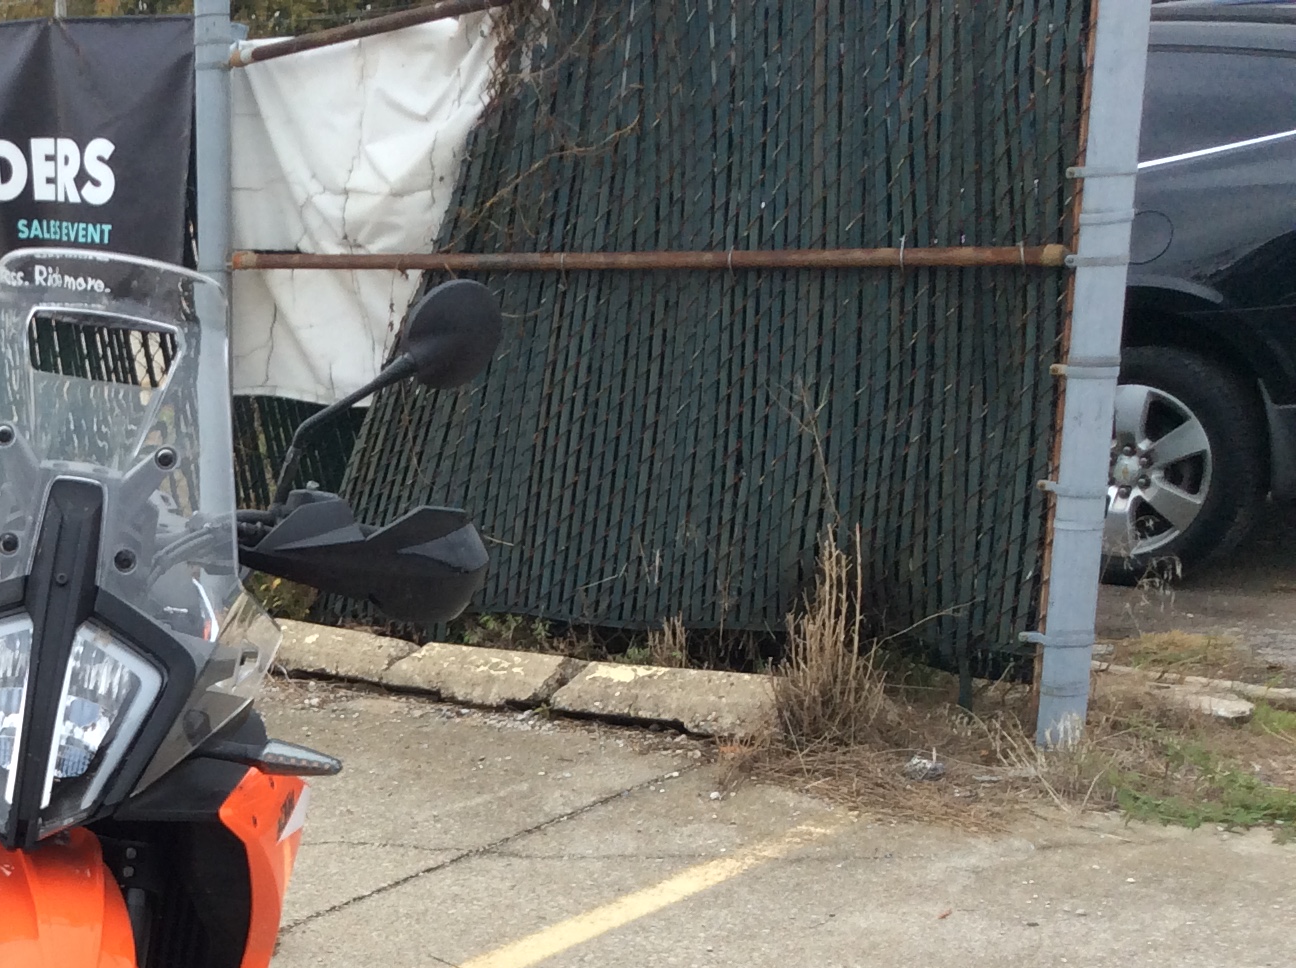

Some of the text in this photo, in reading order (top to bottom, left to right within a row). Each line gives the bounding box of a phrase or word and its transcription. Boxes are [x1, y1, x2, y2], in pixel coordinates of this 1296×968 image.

[17, 218, 113, 245] SALES EVENT
[63, 274, 111, 293] more.
